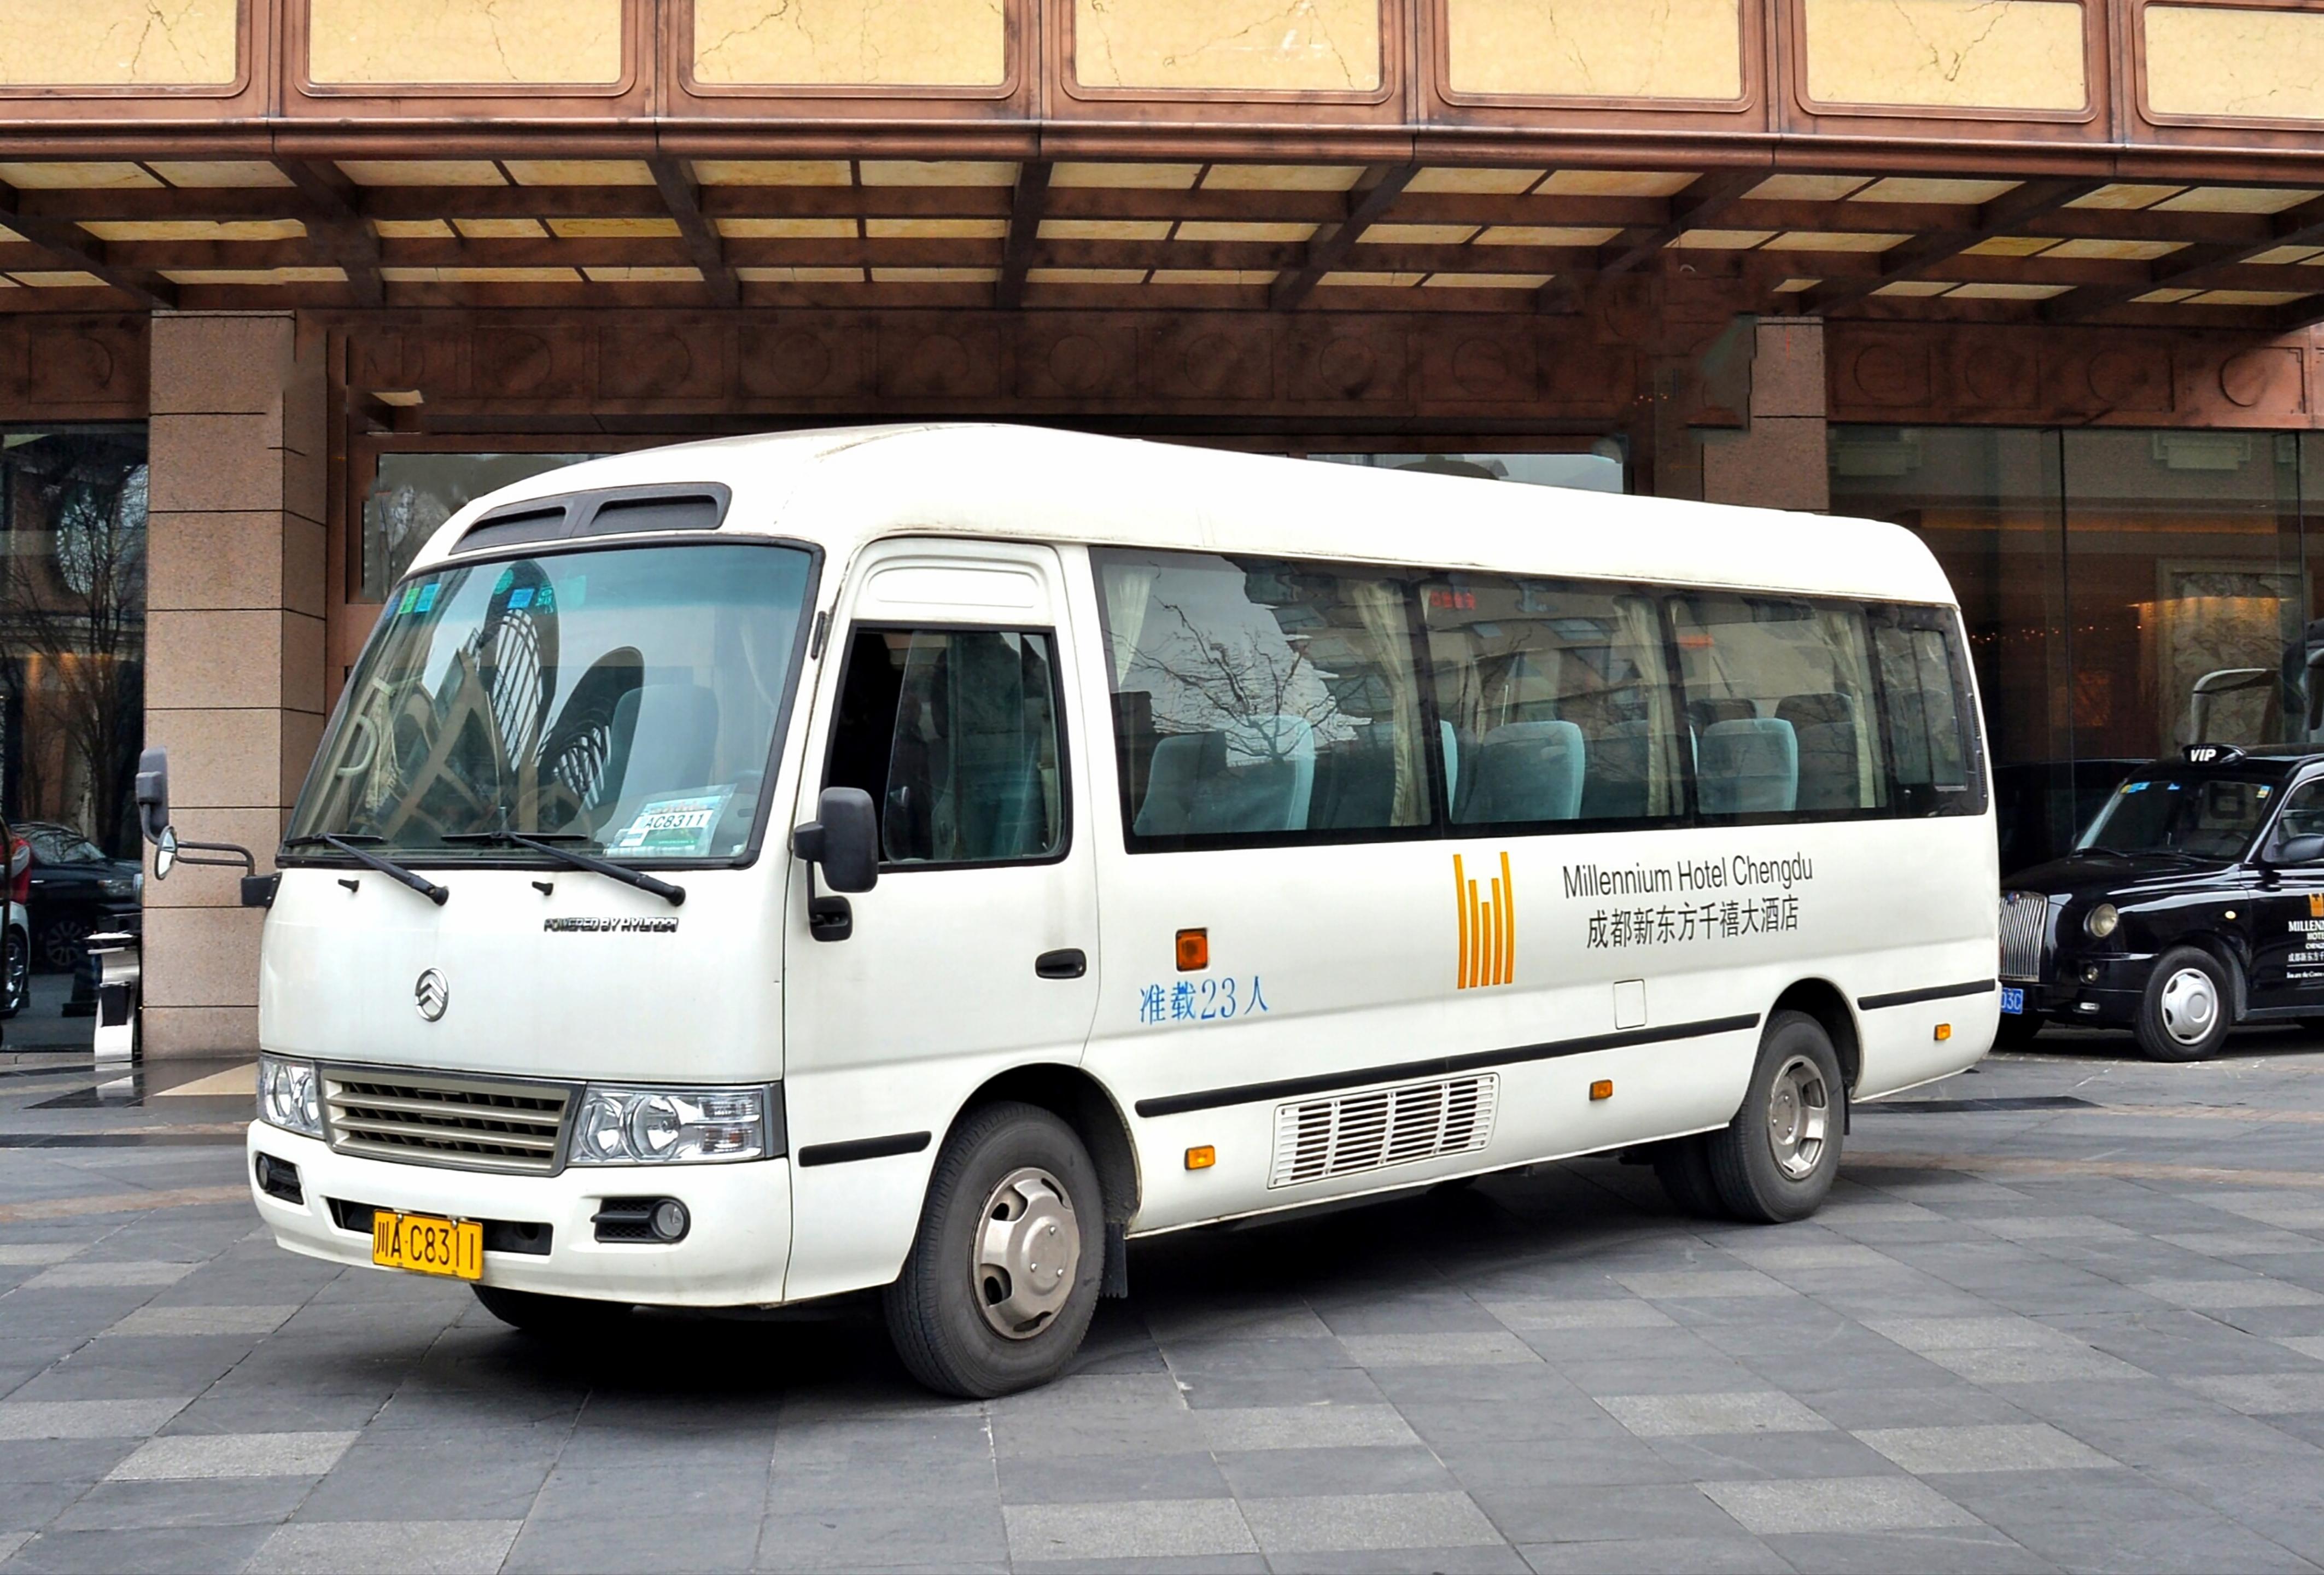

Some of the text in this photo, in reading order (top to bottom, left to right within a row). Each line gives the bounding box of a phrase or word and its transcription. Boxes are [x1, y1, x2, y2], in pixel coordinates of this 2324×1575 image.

[2191, 749, 2216, 762] VIP
[644, 813, 705, 828] AC8311
[1563, 851, 1813, 899] Millennium Hotel Chengdu
[601, 917, 621, 932] BY
[1586, 894, 1799, 948] 成都新东方千禧大酒店
[1140, 976, 1269, 1024] 准载23人
